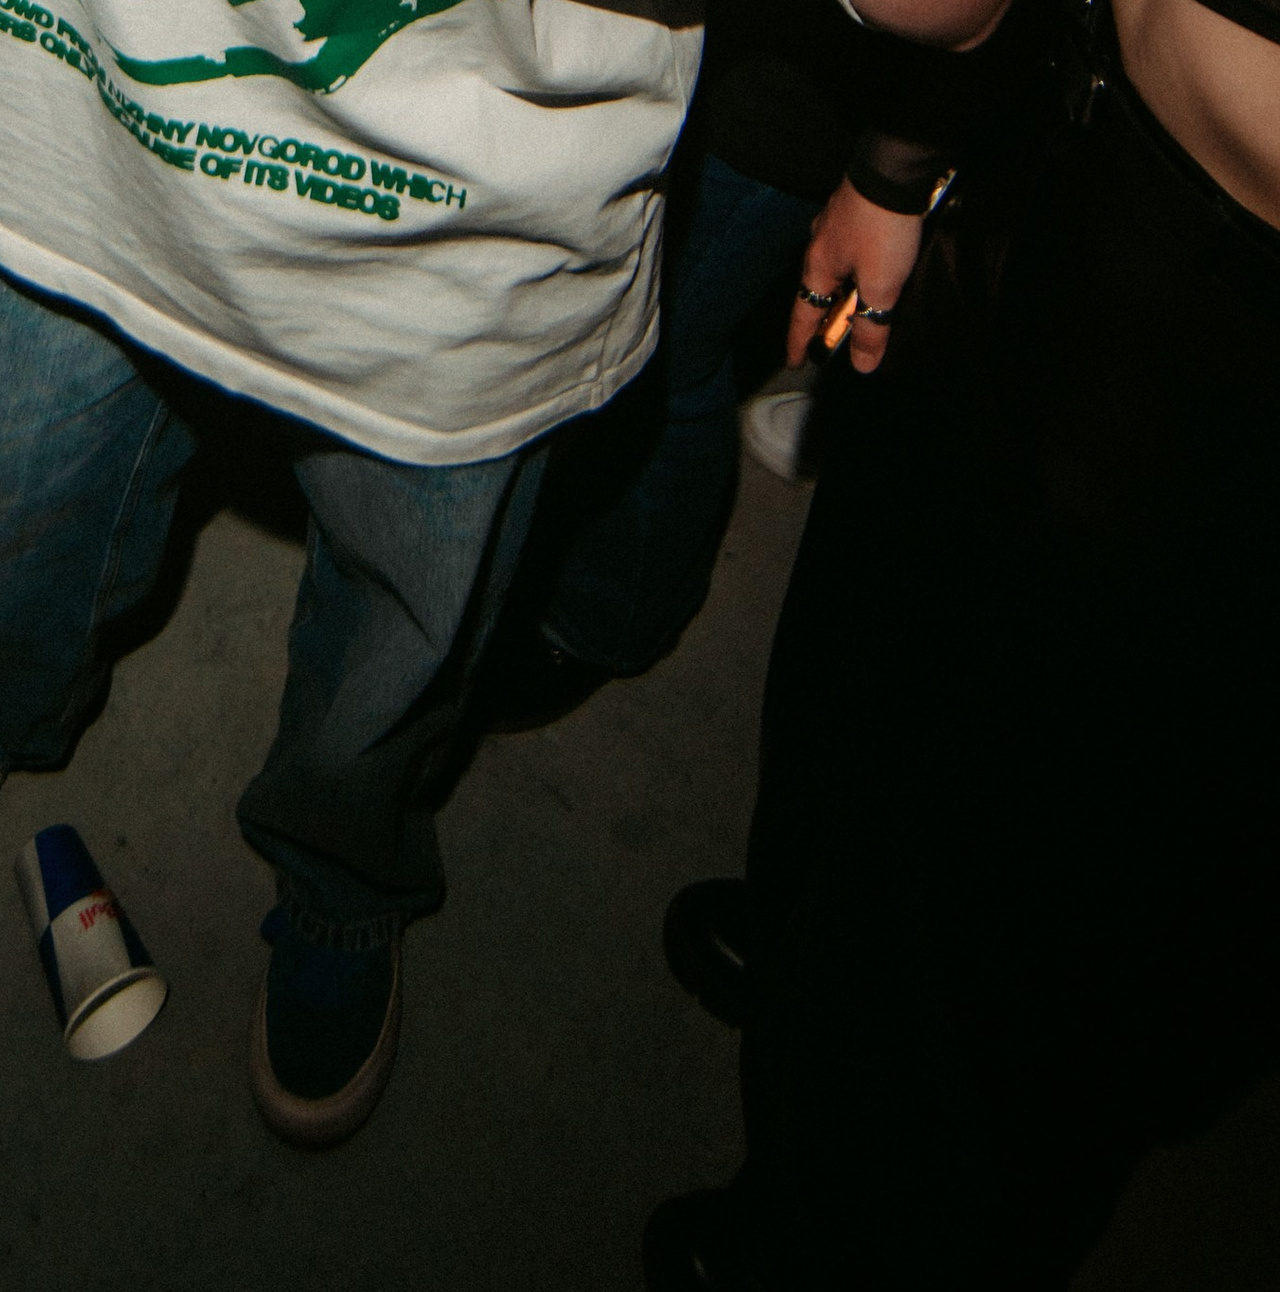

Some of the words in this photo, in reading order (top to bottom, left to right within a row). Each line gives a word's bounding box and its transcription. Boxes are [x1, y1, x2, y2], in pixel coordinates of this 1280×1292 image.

[196, 122, 366, 180] NOVGOROD
[371, 160, 467, 209] WHICH
[200, 153, 243, 180] OF
[244, 160, 290, 191] ITS
[295, 169, 401, 221] VIDEOS
